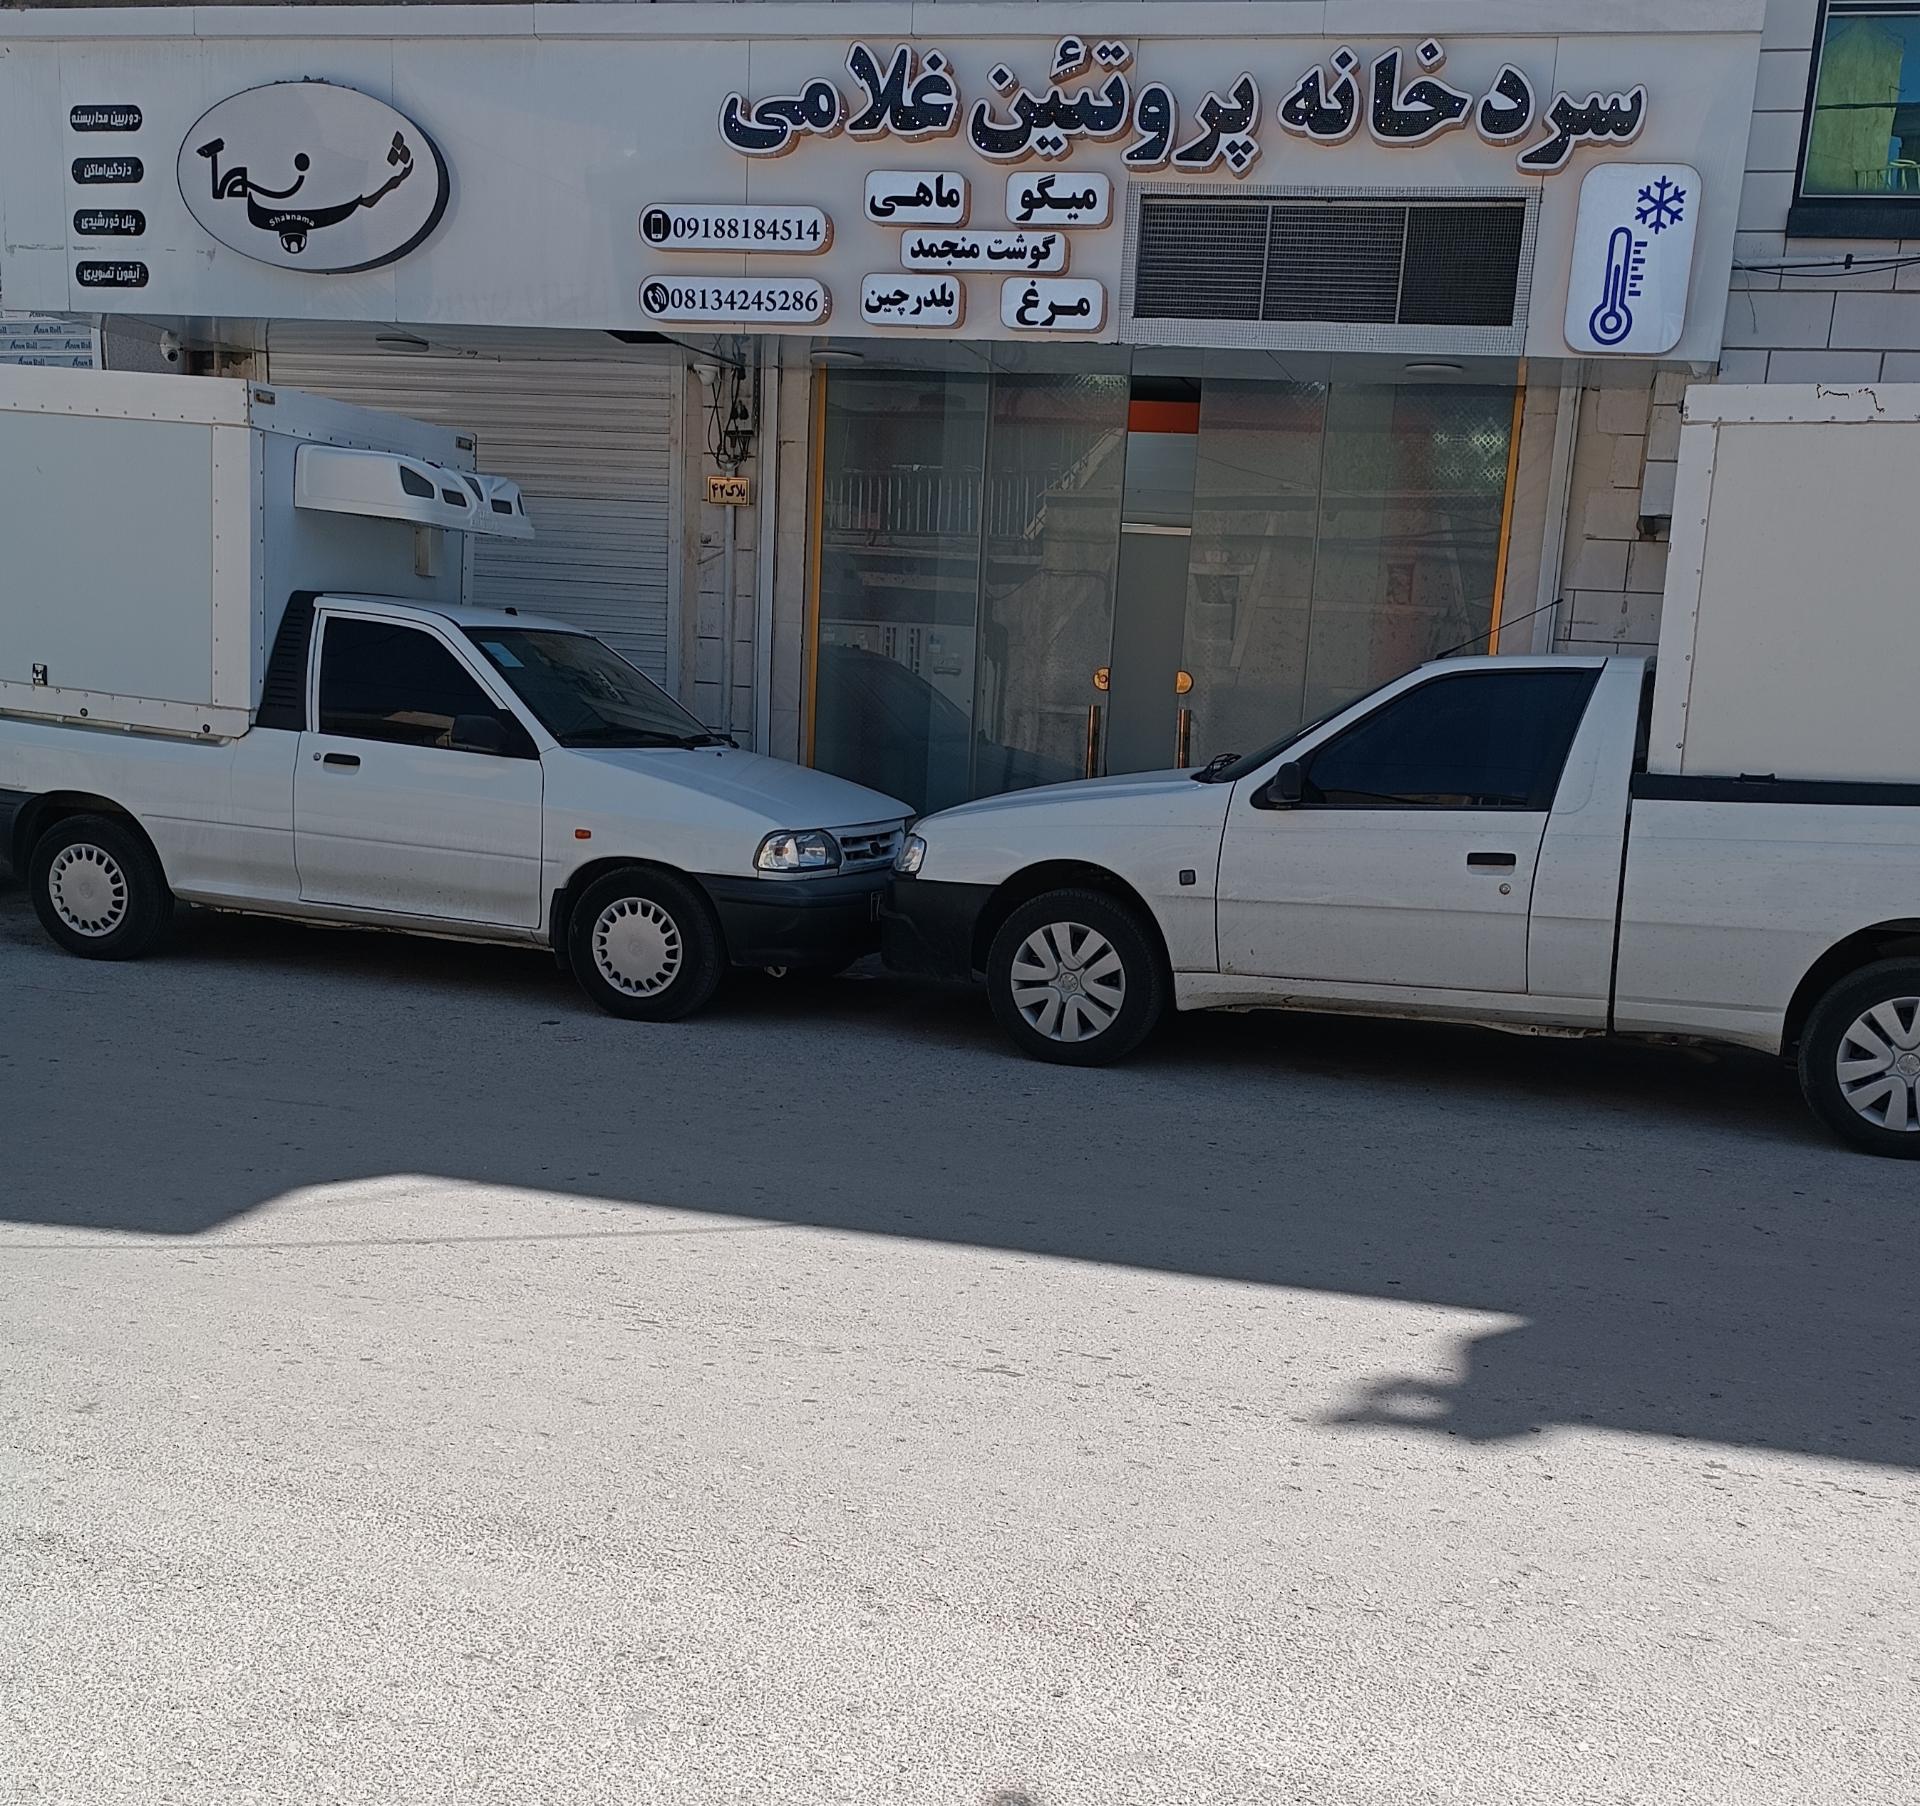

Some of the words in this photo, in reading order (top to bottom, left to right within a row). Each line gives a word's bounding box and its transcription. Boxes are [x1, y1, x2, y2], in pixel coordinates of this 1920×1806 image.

[718, 40, 964, 158] غلامی
[968, 35, 1260, 178] پروتئین
[1278, 38, 1648, 175] سردخانه
[110, 110, 138, 126] دوربین
[869, 174, 960, 217] ماهی
[1016, 174, 1098, 222] میگو
[81, 211, 120, 230] خورشیدی
[121, 214, 136, 233] پنل
[268, 212, 315, 227] Shabnama
[673, 217, 821, 242] 09188184514
[910, 236, 980, 266] منجمد
[986, 234, 1057, 269] گوشت
[83, 266, 115, 283] تصویری
[116, 264, 142, 283] آیفون
[670, 288, 818, 312] 08134245286
[865, 282, 955, 316] بلدرچین
[1016, 280, 1091, 326] مرغ
